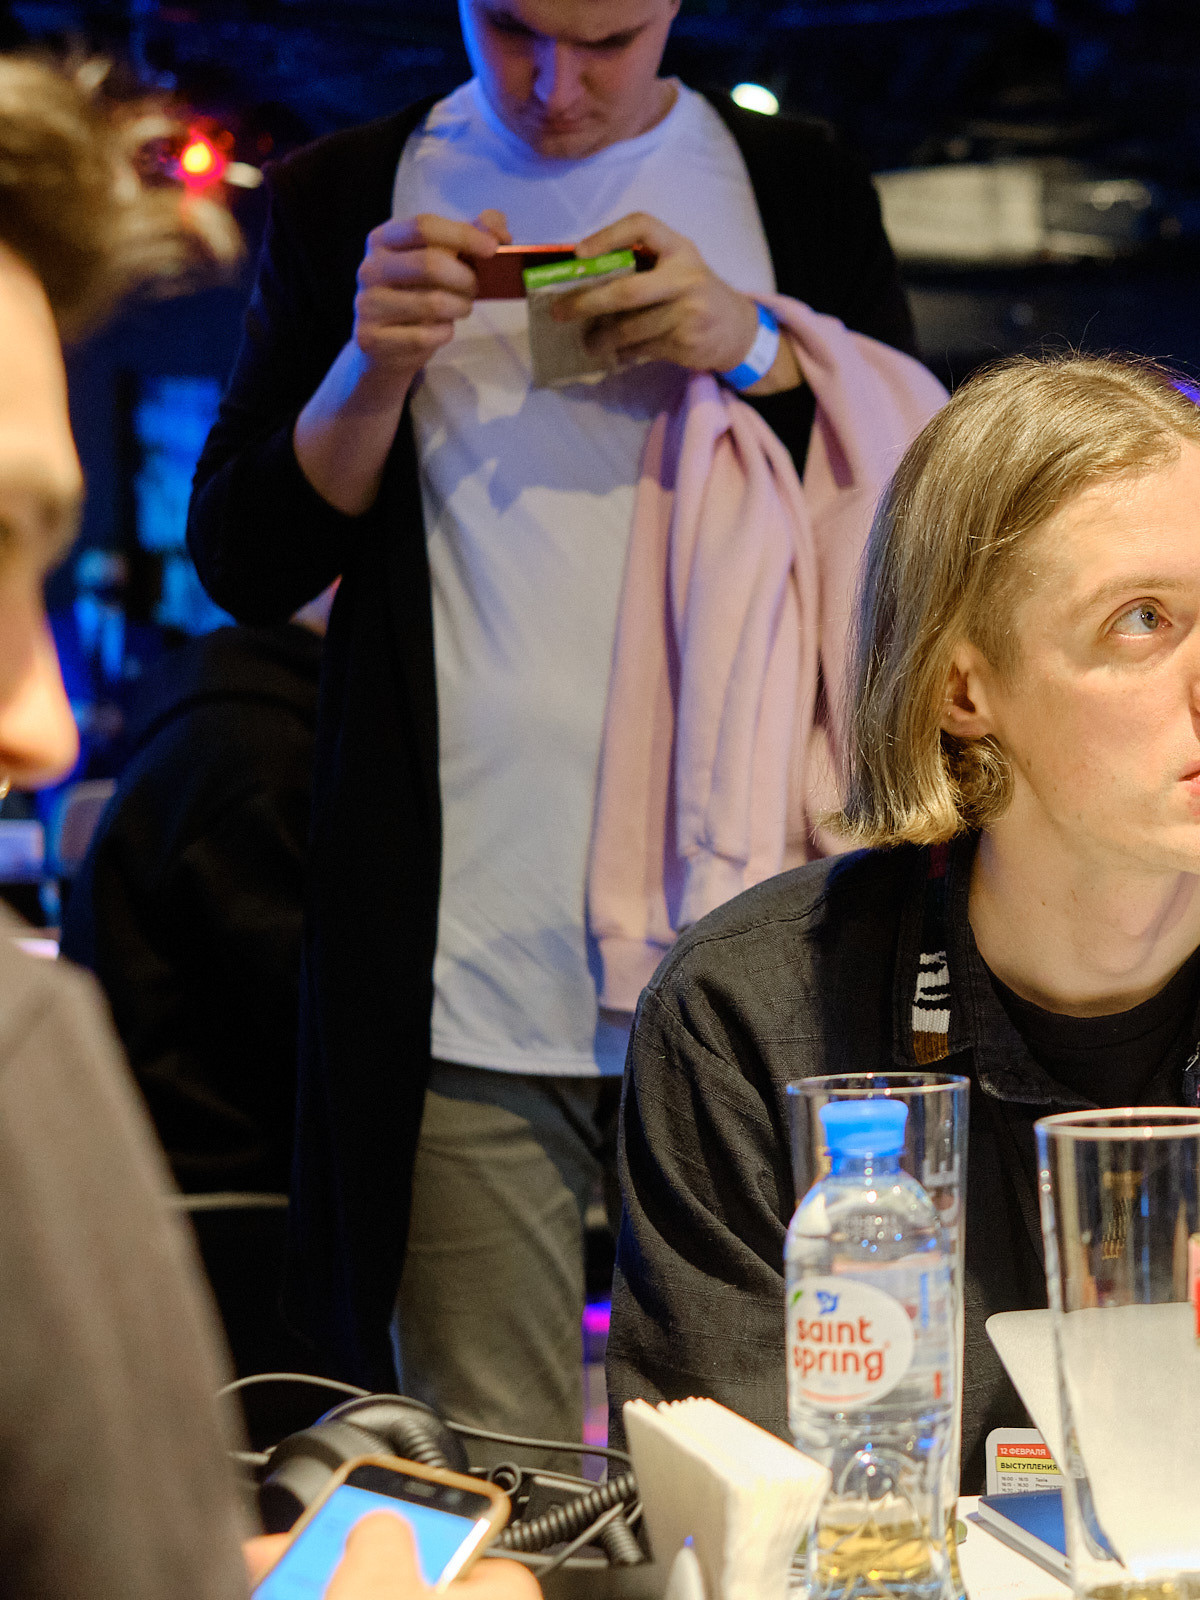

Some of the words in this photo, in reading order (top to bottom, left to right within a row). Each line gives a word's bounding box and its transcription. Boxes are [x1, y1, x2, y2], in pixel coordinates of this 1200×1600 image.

[797, 1316, 873, 1344] saint
[794, 1346, 885, 1383] spring
[1000, 1447, 1008, 1455] 12
[1008, 1447, 1046, 1456] ФЕВРАЛЯ
[1000, 1462, 1058, 1471] ВЫСТУПЛЕНИЯ
